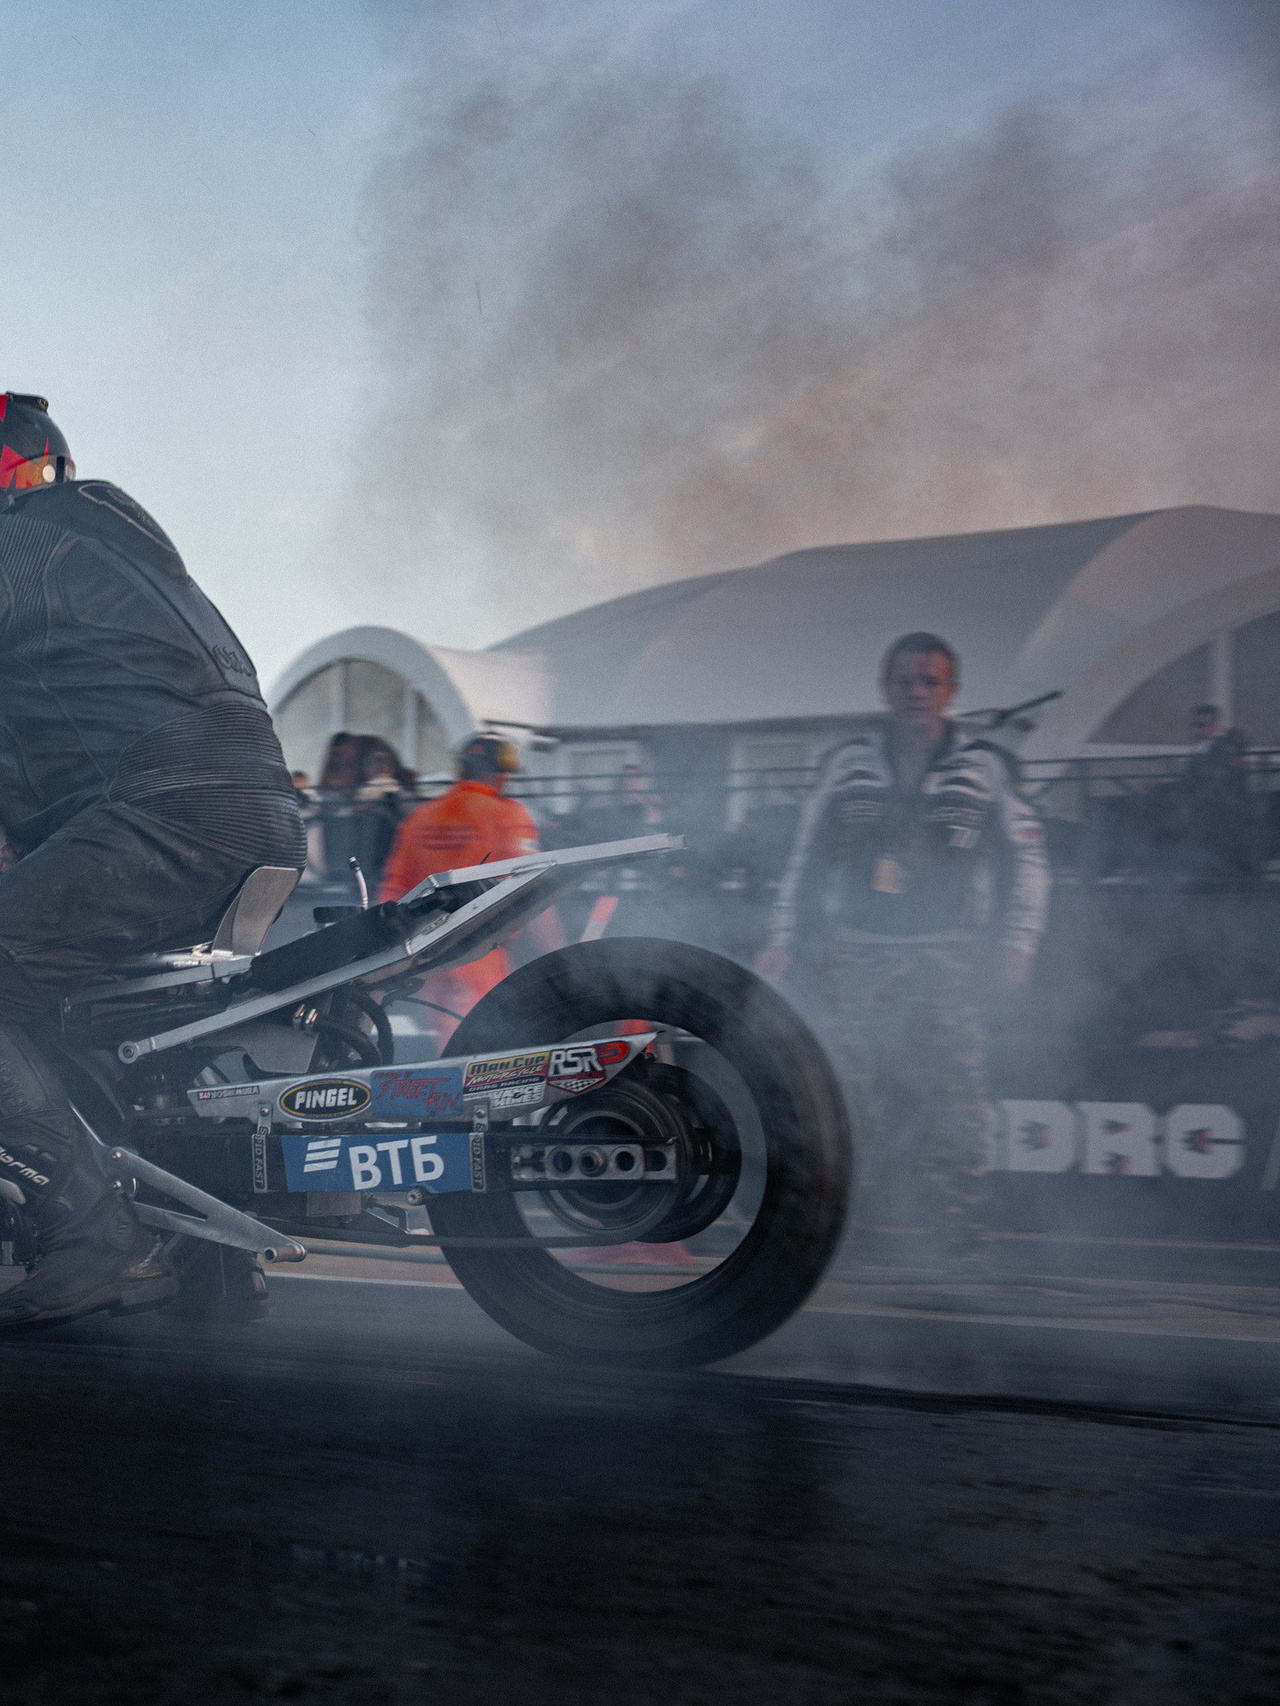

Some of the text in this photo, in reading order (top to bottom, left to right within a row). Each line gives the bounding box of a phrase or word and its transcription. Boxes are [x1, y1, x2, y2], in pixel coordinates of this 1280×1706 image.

[470, 1055, 546, 1075] MAN CUP
[547, 1047, 604, 1077] RSR
[294, 1087, 358, 1110] PINGEL
[980, 1099, 1246, 1179] DRC
[349, 1135, 445, 1191] ВТБ
